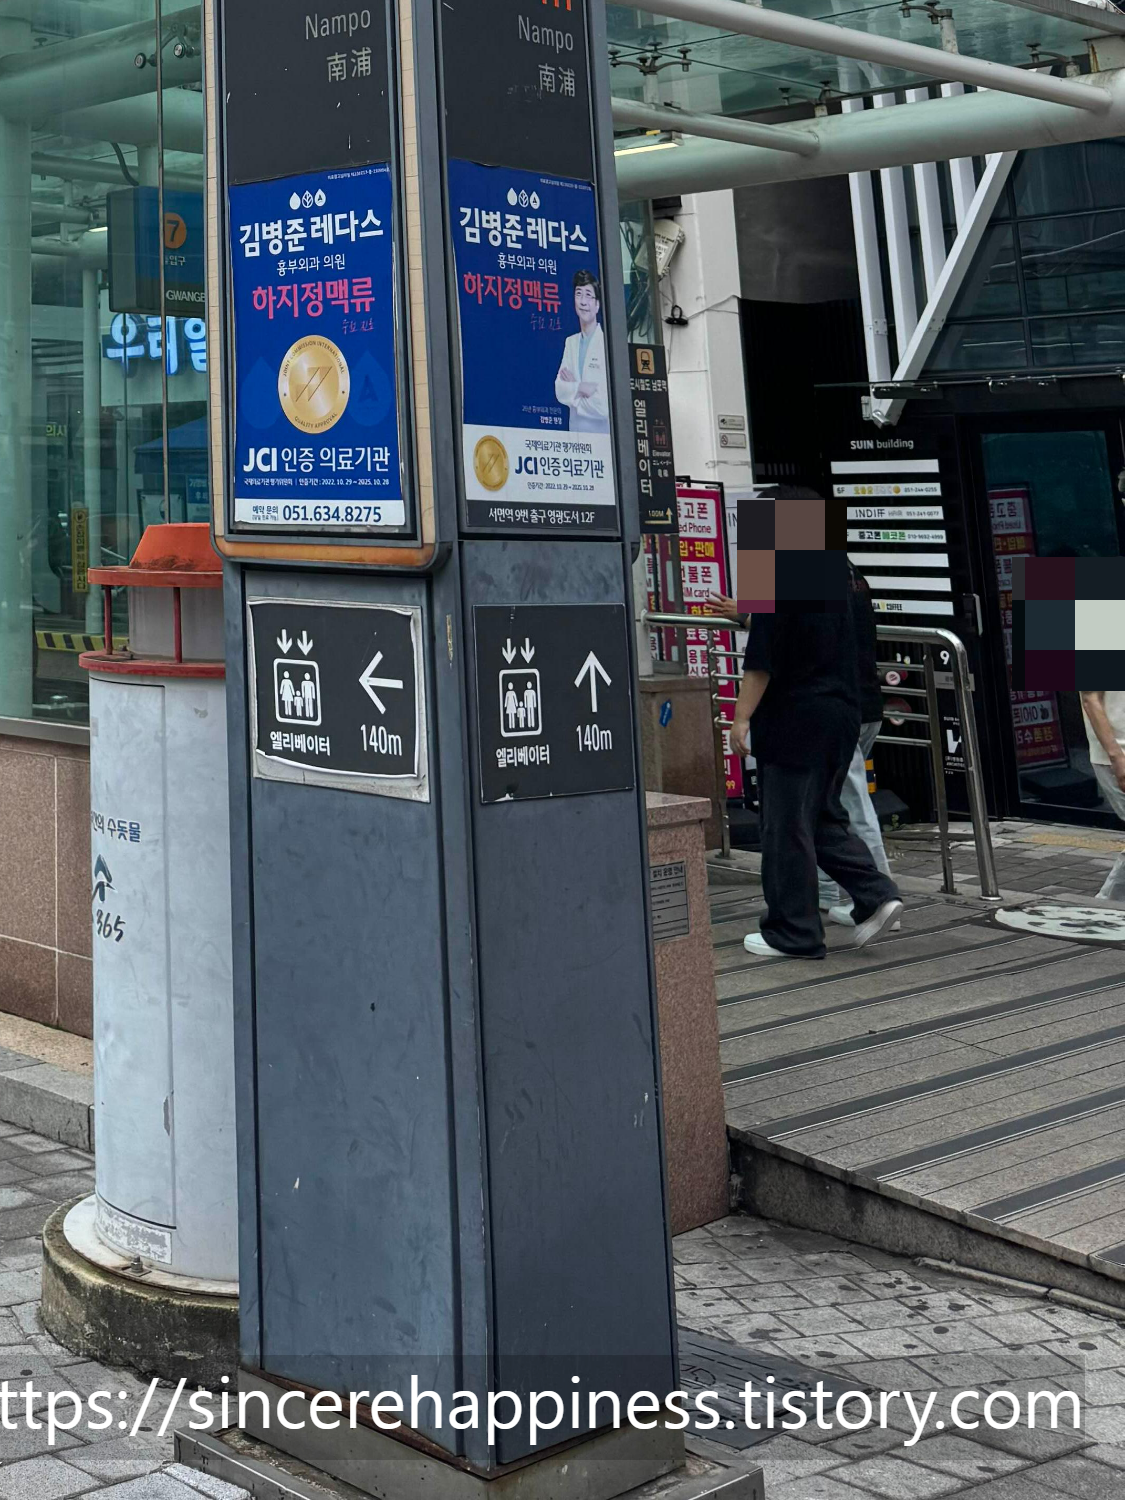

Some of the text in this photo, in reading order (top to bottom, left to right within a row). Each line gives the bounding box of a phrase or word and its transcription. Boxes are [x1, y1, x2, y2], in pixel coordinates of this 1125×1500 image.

[305, 9, 371, 40] Nampo
[518, 14, 574, 52] Nampo
[327, 47, 372, 82] 南浦
[539, 63, 576, 98] 南浦
[166, 219, 180, 242] 7
[277, 253, 346, 276] 흉부외과 의원
[497, 253, 557, 275] 흉부외과 의원
[252, 277, 375, 319] 하지정맥류
[463, 272, 561, 314] 하지정맥류
[525, 439, 561, 452] 국제의료기관
[634, 399, 653, 496] 엘리베이터
[850, 439, 914, 450] SUIN building
[244, 446, 390, 472] JCI 인증 의료기관
[515, 456, 604, 479] JCI 인증 의료기관
[283, 505, 382, 522] 051.634.8275
[489, 508, 595, 524] 서면역 9번 출구 영광도서 12F
[688, 522, 711, 534] Phone
[694, 587, 711, 598] card
[270, 724, 402, 756] 엘리베이터 140m
[496, 723, 613, 768] 엘리베이터 140m
[107, 817, 141, 843] 수돗물
[96, 909, 126, 942] 365
